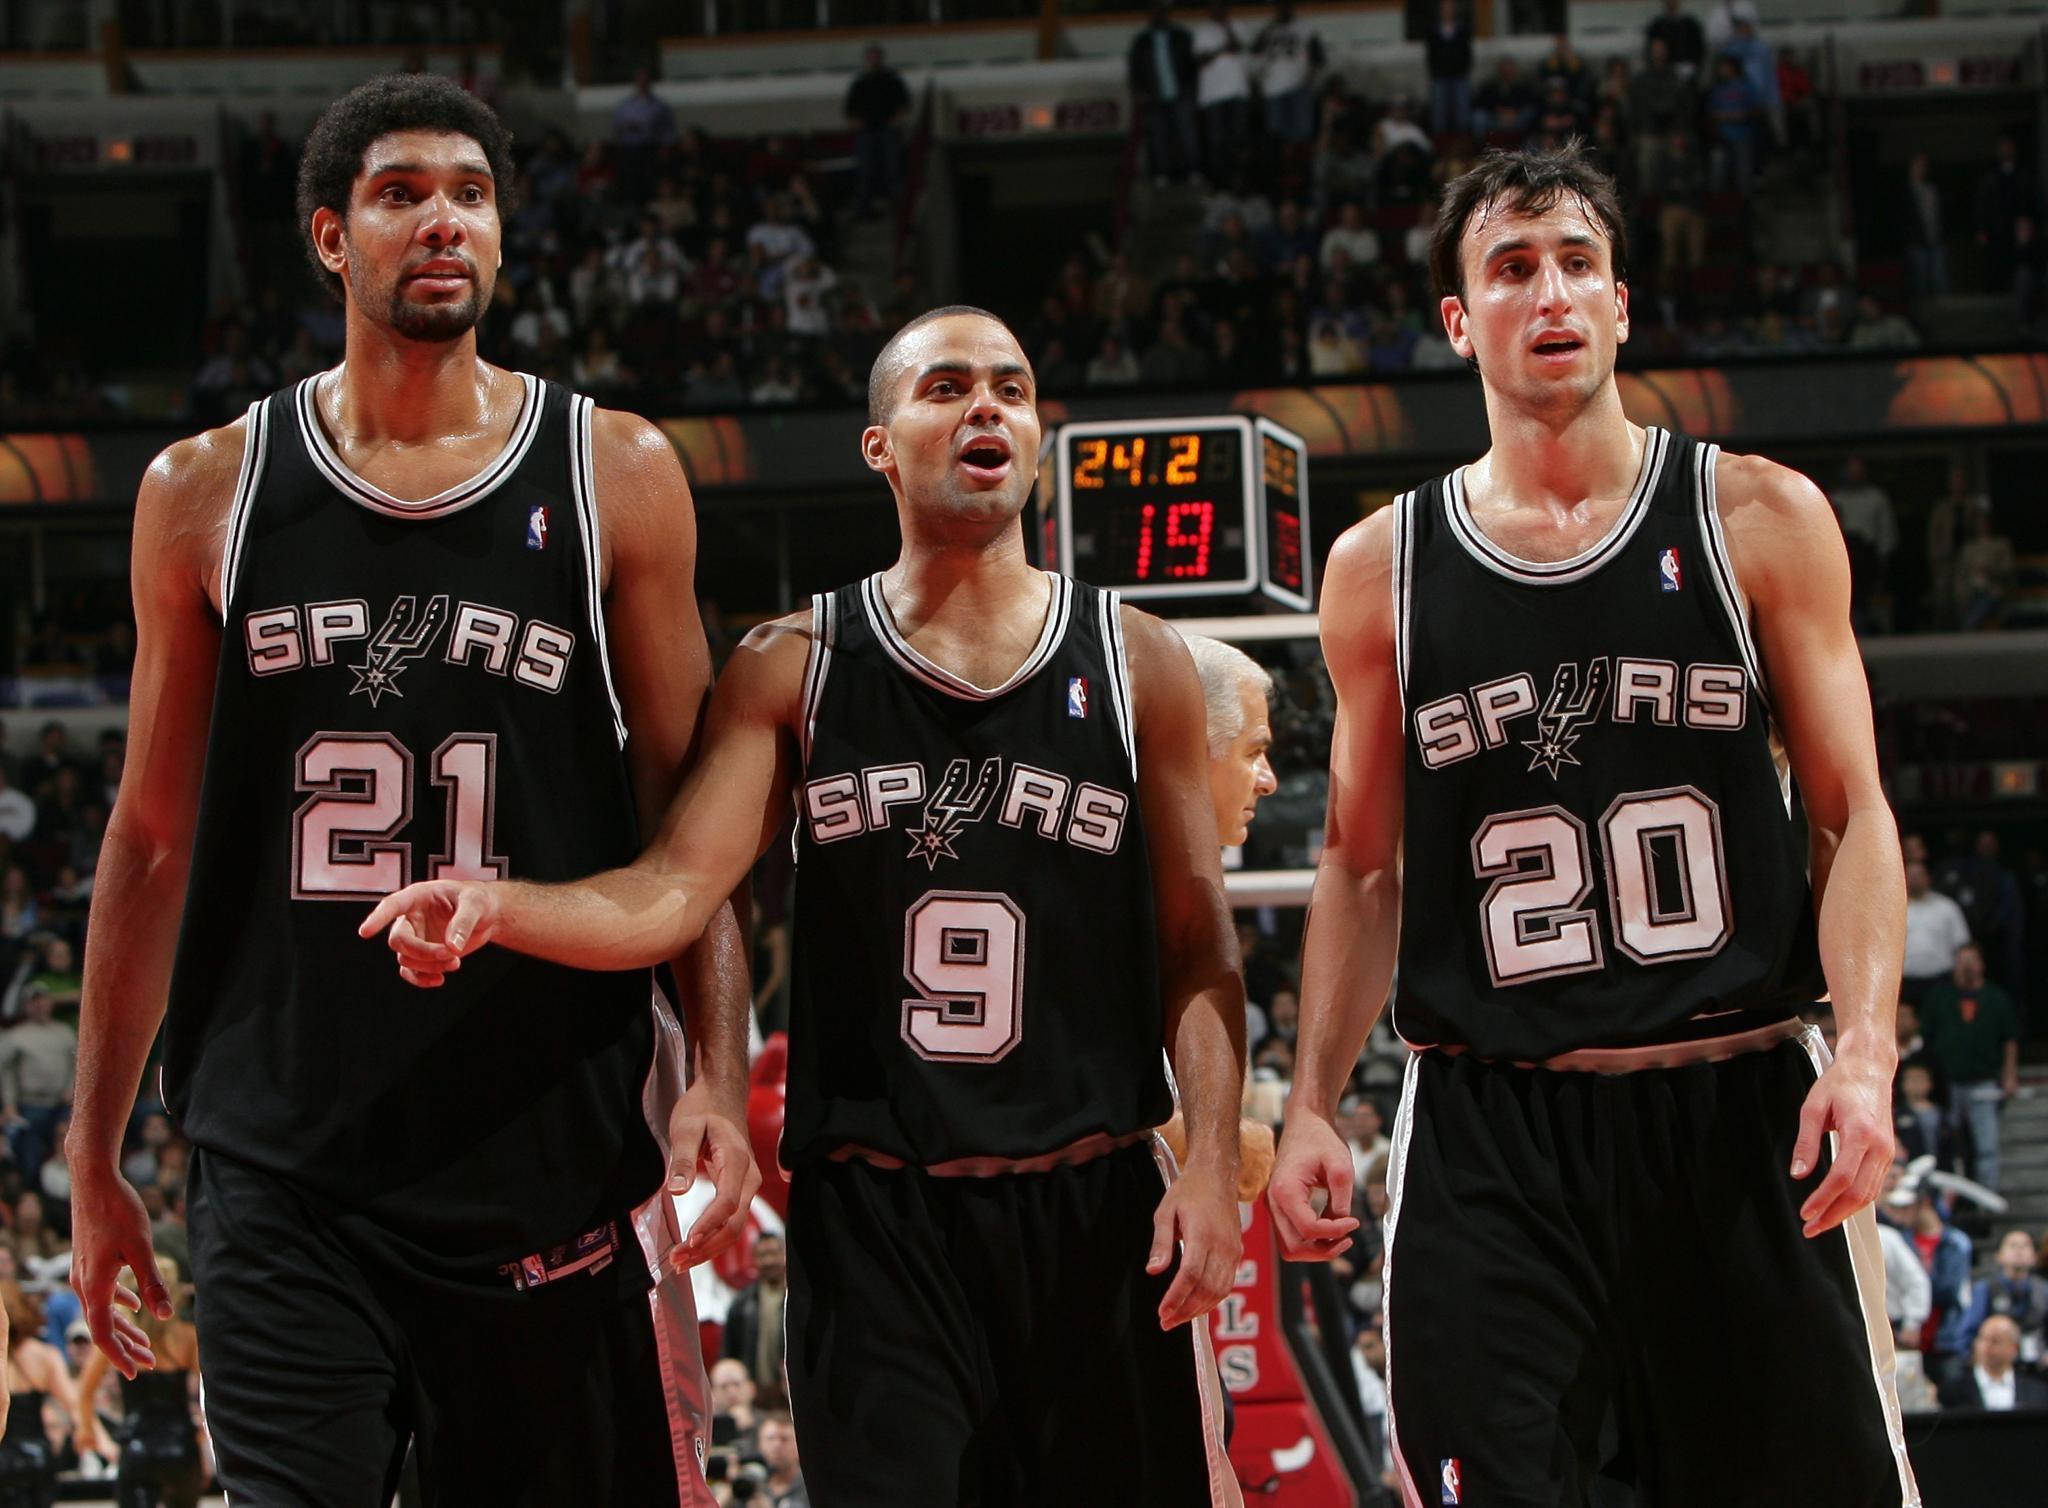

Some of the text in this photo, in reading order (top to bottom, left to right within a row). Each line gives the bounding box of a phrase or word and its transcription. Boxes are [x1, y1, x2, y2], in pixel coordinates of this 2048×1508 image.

[1074, 435, 1200, 489] 24.2
[1136, 502, 1214, 579] 19
[244, 594, 575, 707] SPURS
[1413, 656, 1749, 780] SPURS
[291, 731, 508, 900] 21
[805, 755, 1129, 871] SPURS
[1470, 785, 1734, 988] 20
[901, 889, 1026, 1064] 9
